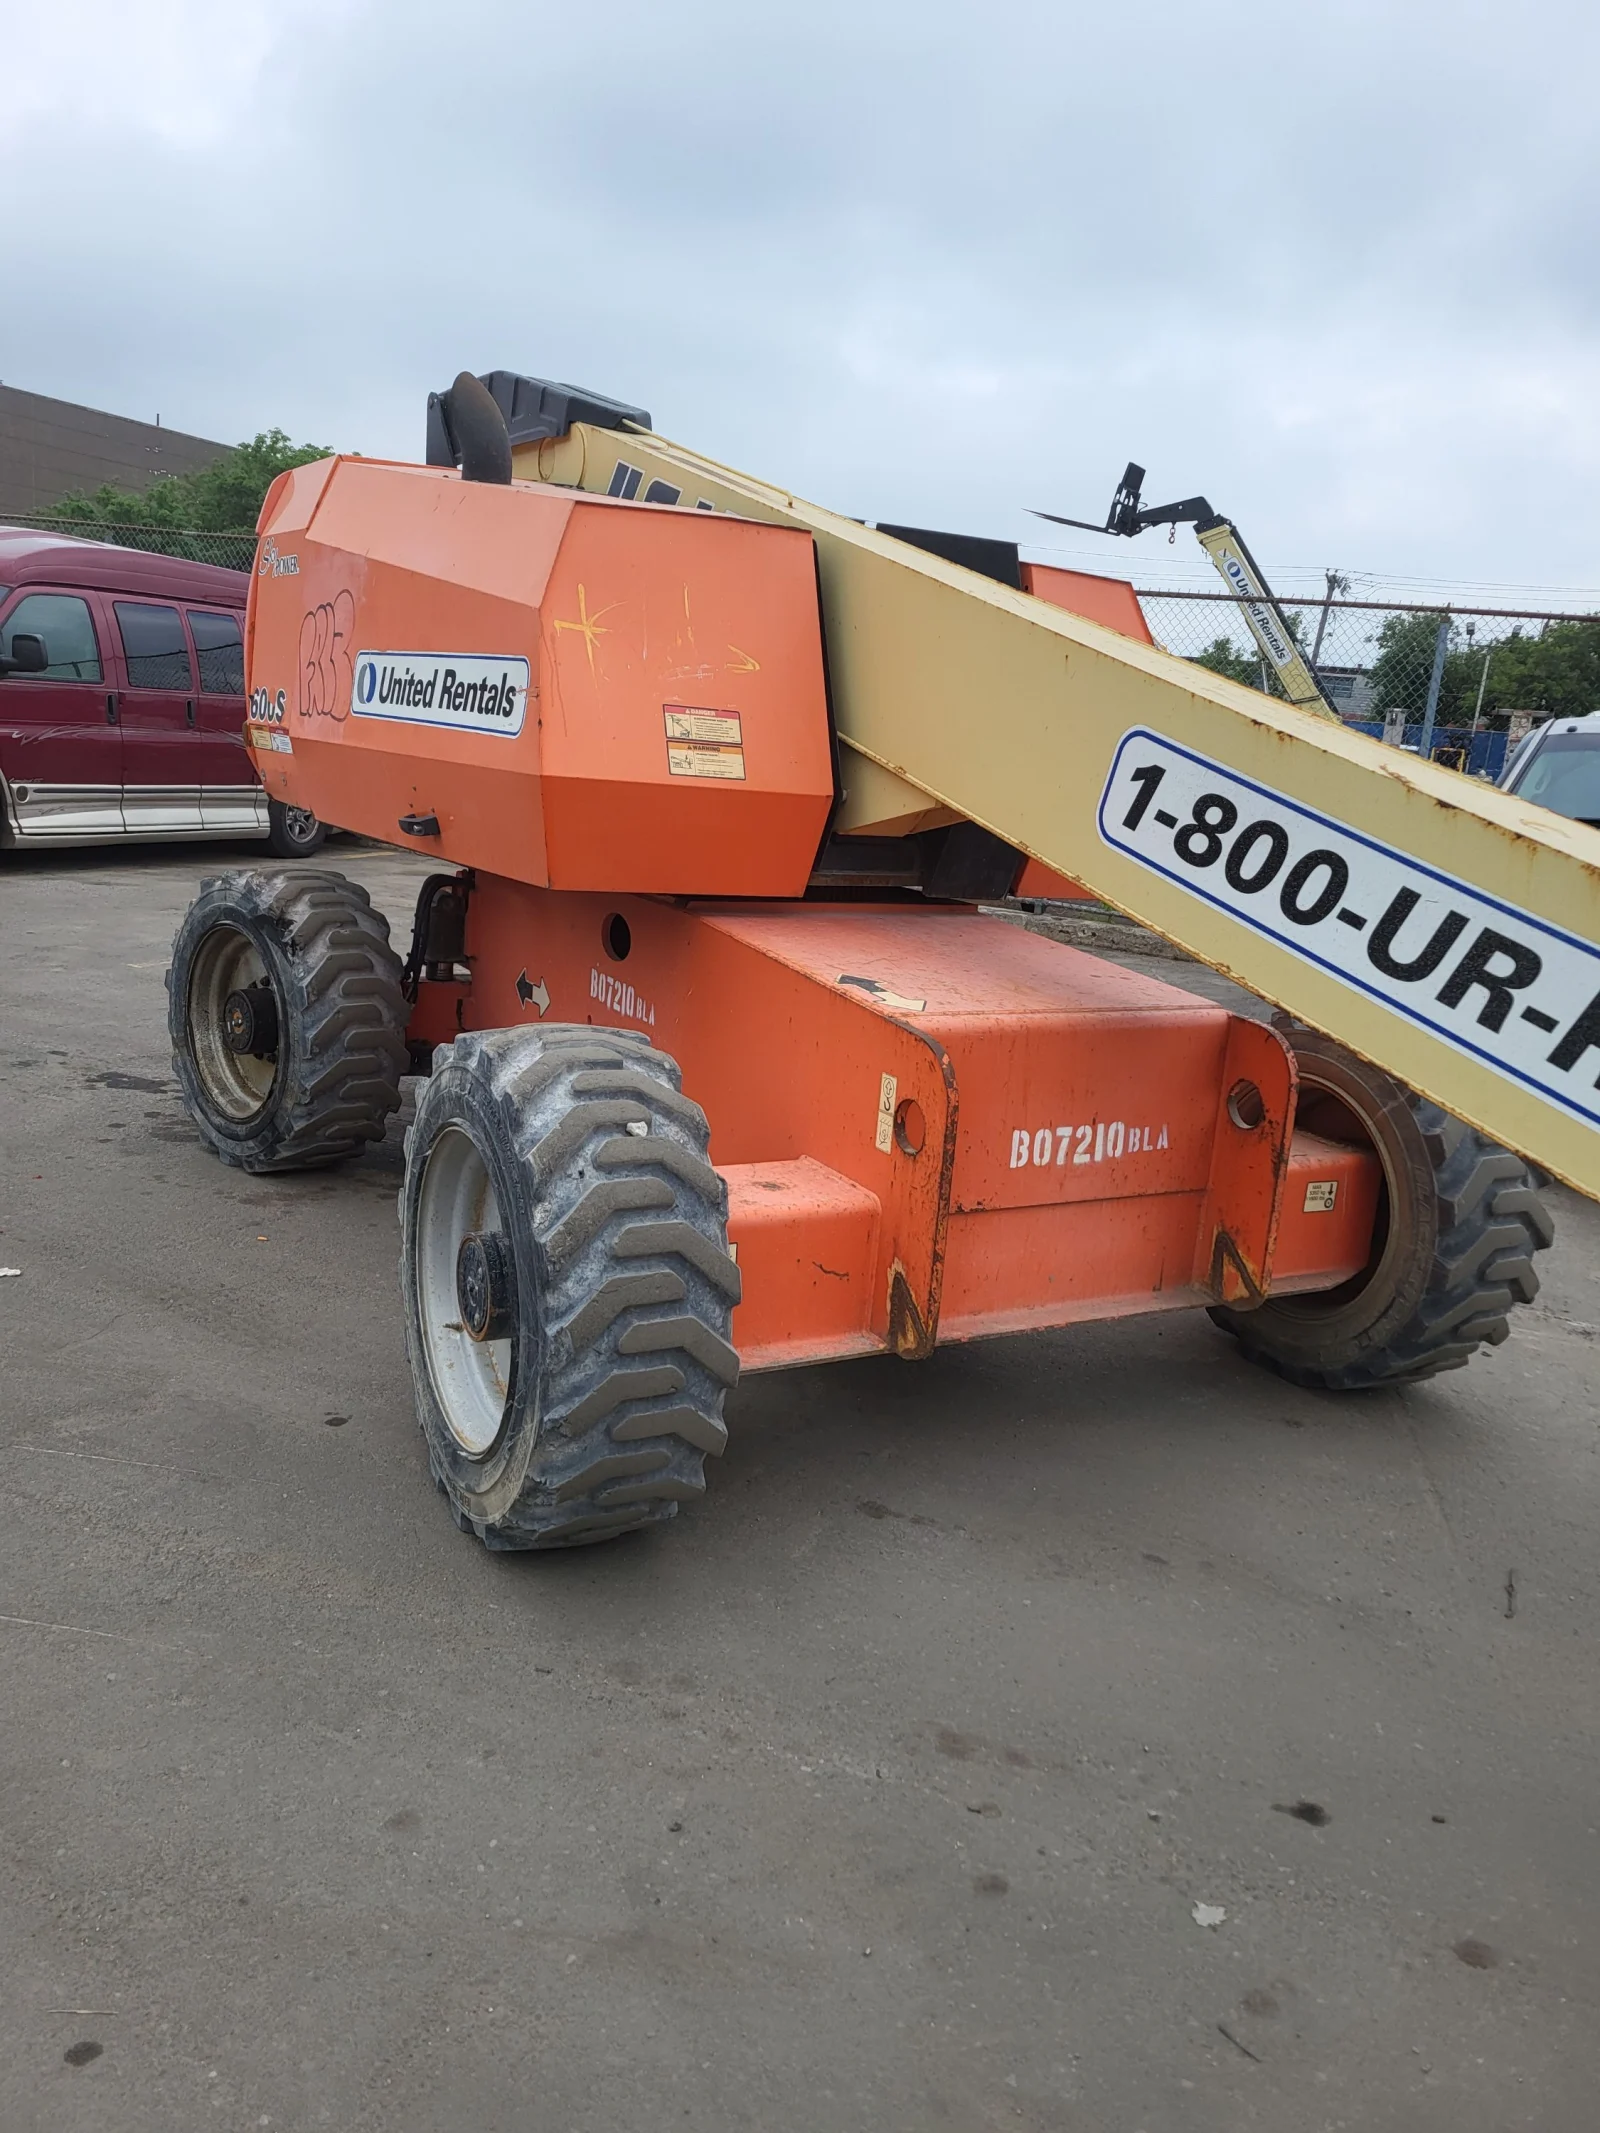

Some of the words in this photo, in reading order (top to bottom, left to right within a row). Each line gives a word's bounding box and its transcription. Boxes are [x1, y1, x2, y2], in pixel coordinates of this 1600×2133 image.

[1236, 578, 1264, 617] Uned
[1257, 617, 1286, 659] Rentals
[379, 666, 439, 708] United
[438, 669, 516, 718] Rentals
[636, 996, 655, 1026] BLA
[1128, 1124, 1169, 1152] BLA
